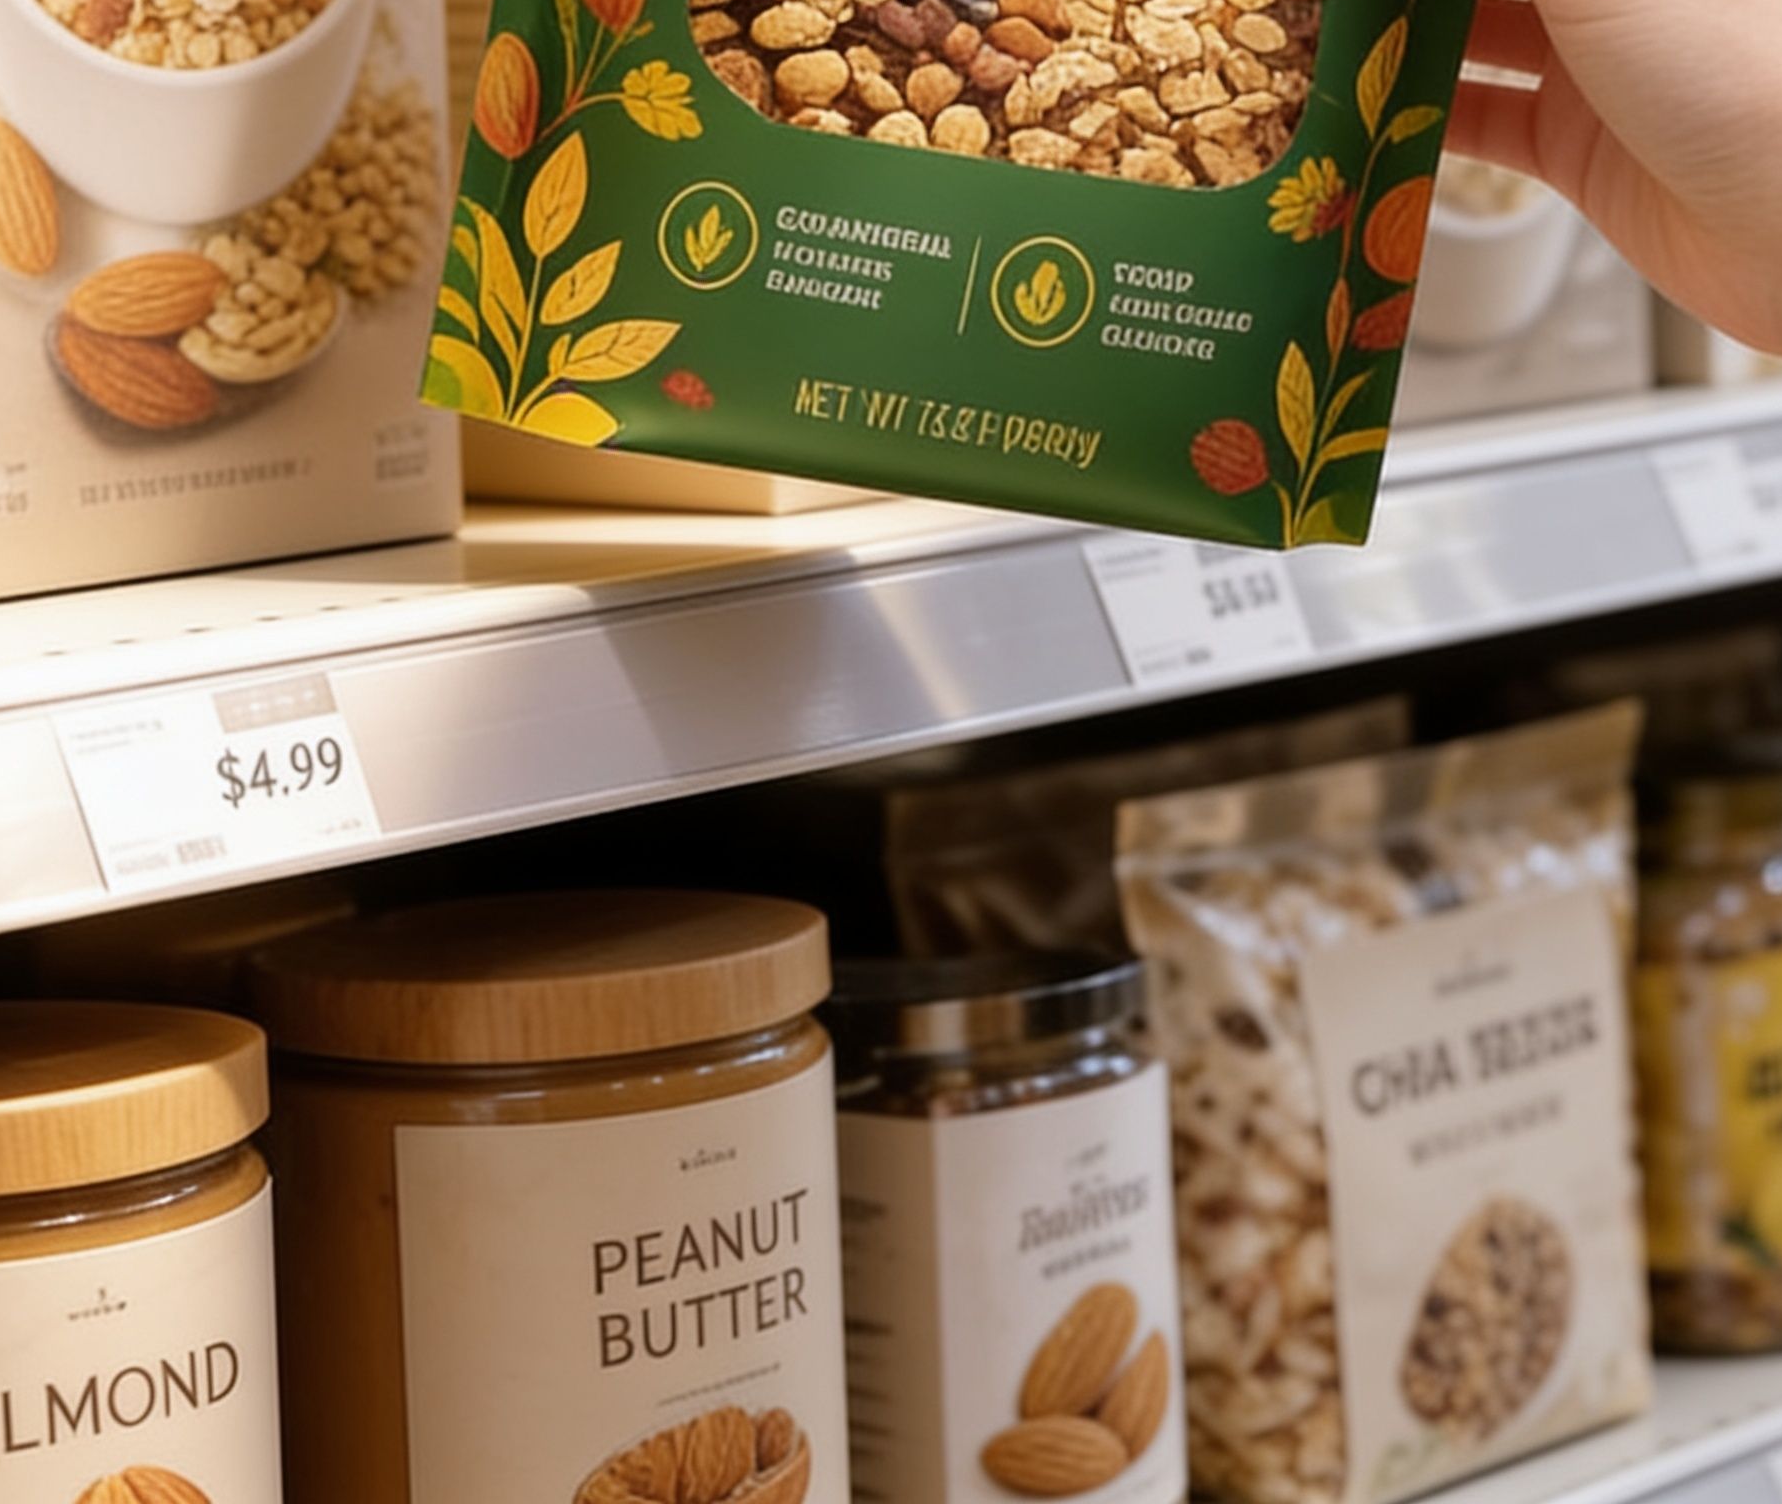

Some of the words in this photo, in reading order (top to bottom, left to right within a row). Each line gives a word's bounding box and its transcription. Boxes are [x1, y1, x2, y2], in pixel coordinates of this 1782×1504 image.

[217, 737, 342, 809] $4.99
[593, 1188, 808, 1295] PEANUT
[598, 1266, 807, 1368] BUTTER
